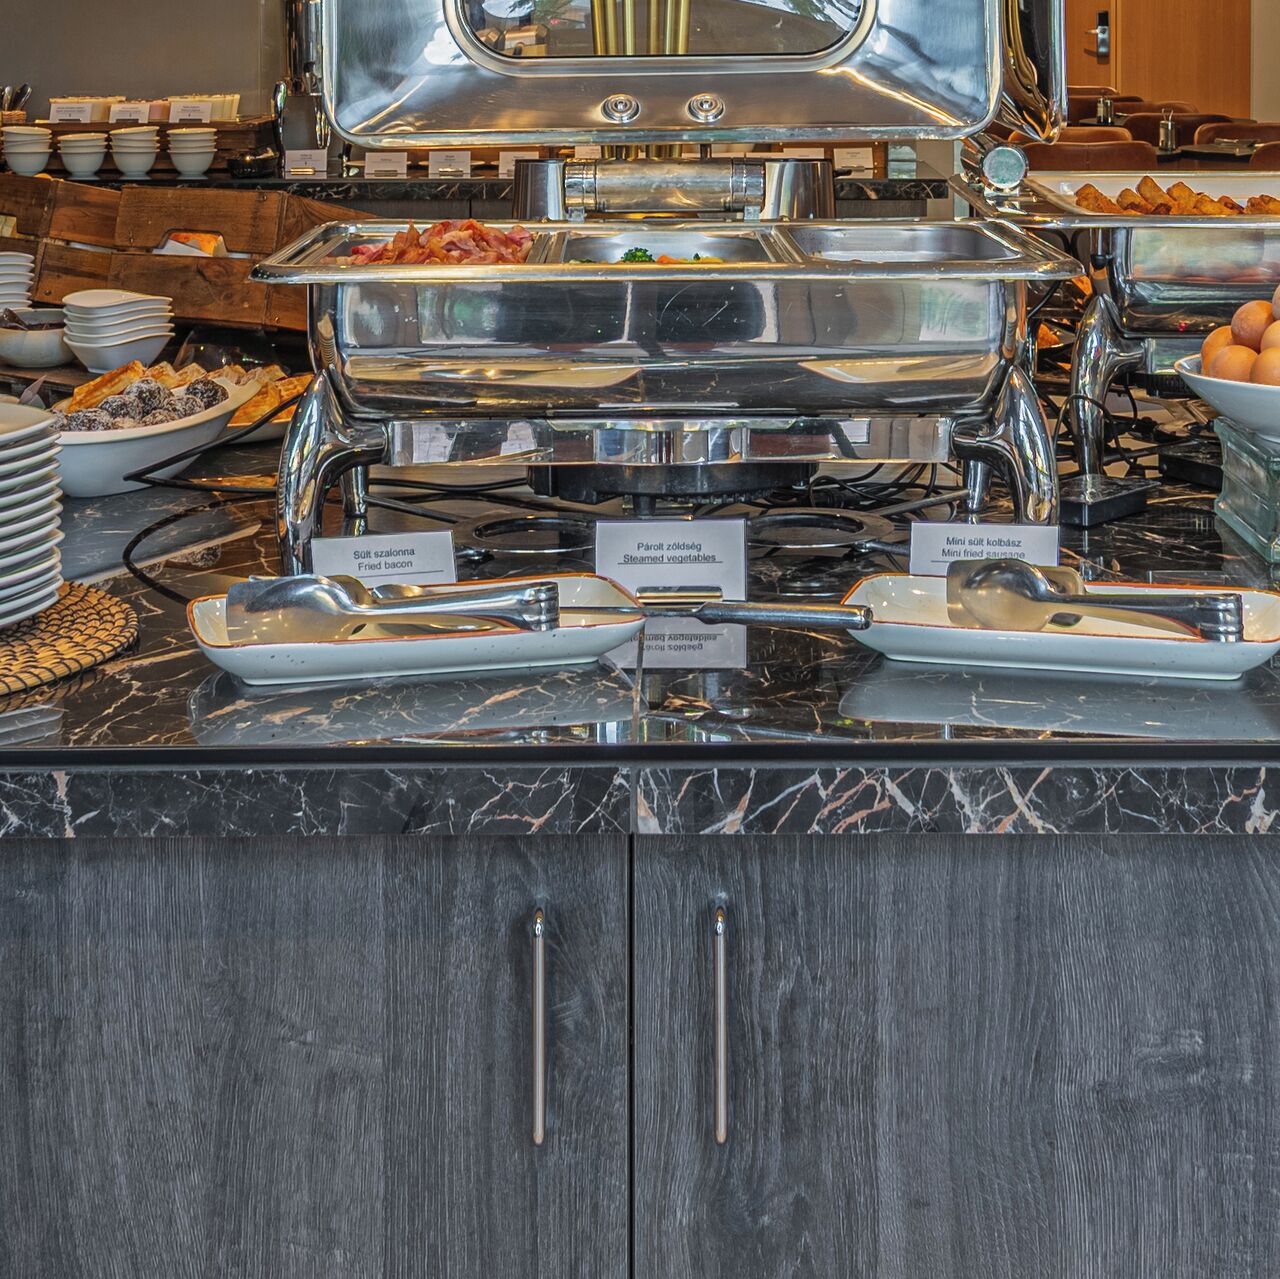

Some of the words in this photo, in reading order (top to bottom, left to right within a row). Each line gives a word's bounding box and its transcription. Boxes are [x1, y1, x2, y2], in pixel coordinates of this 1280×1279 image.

[637, 542, 664, 551] Párolt
[666, 542, 702, 553] zöldség
[946, 536, 966, 546] Mini
[968, 537, 984, 547] sült
[986, 537, 1022, 548] kolbász
[353, 550, 372, 560] Sült
[374, 547, 416, 559] szalonna
[623, 553, 664, 563] Steamed
[666, 553, 717, 564] vegetables
[941, 548, 961, 558] Mini
[963, 548, 984, 558] fried
[358, 561, 382, 571] Fried
[384, 560, 413, 570] bacon
